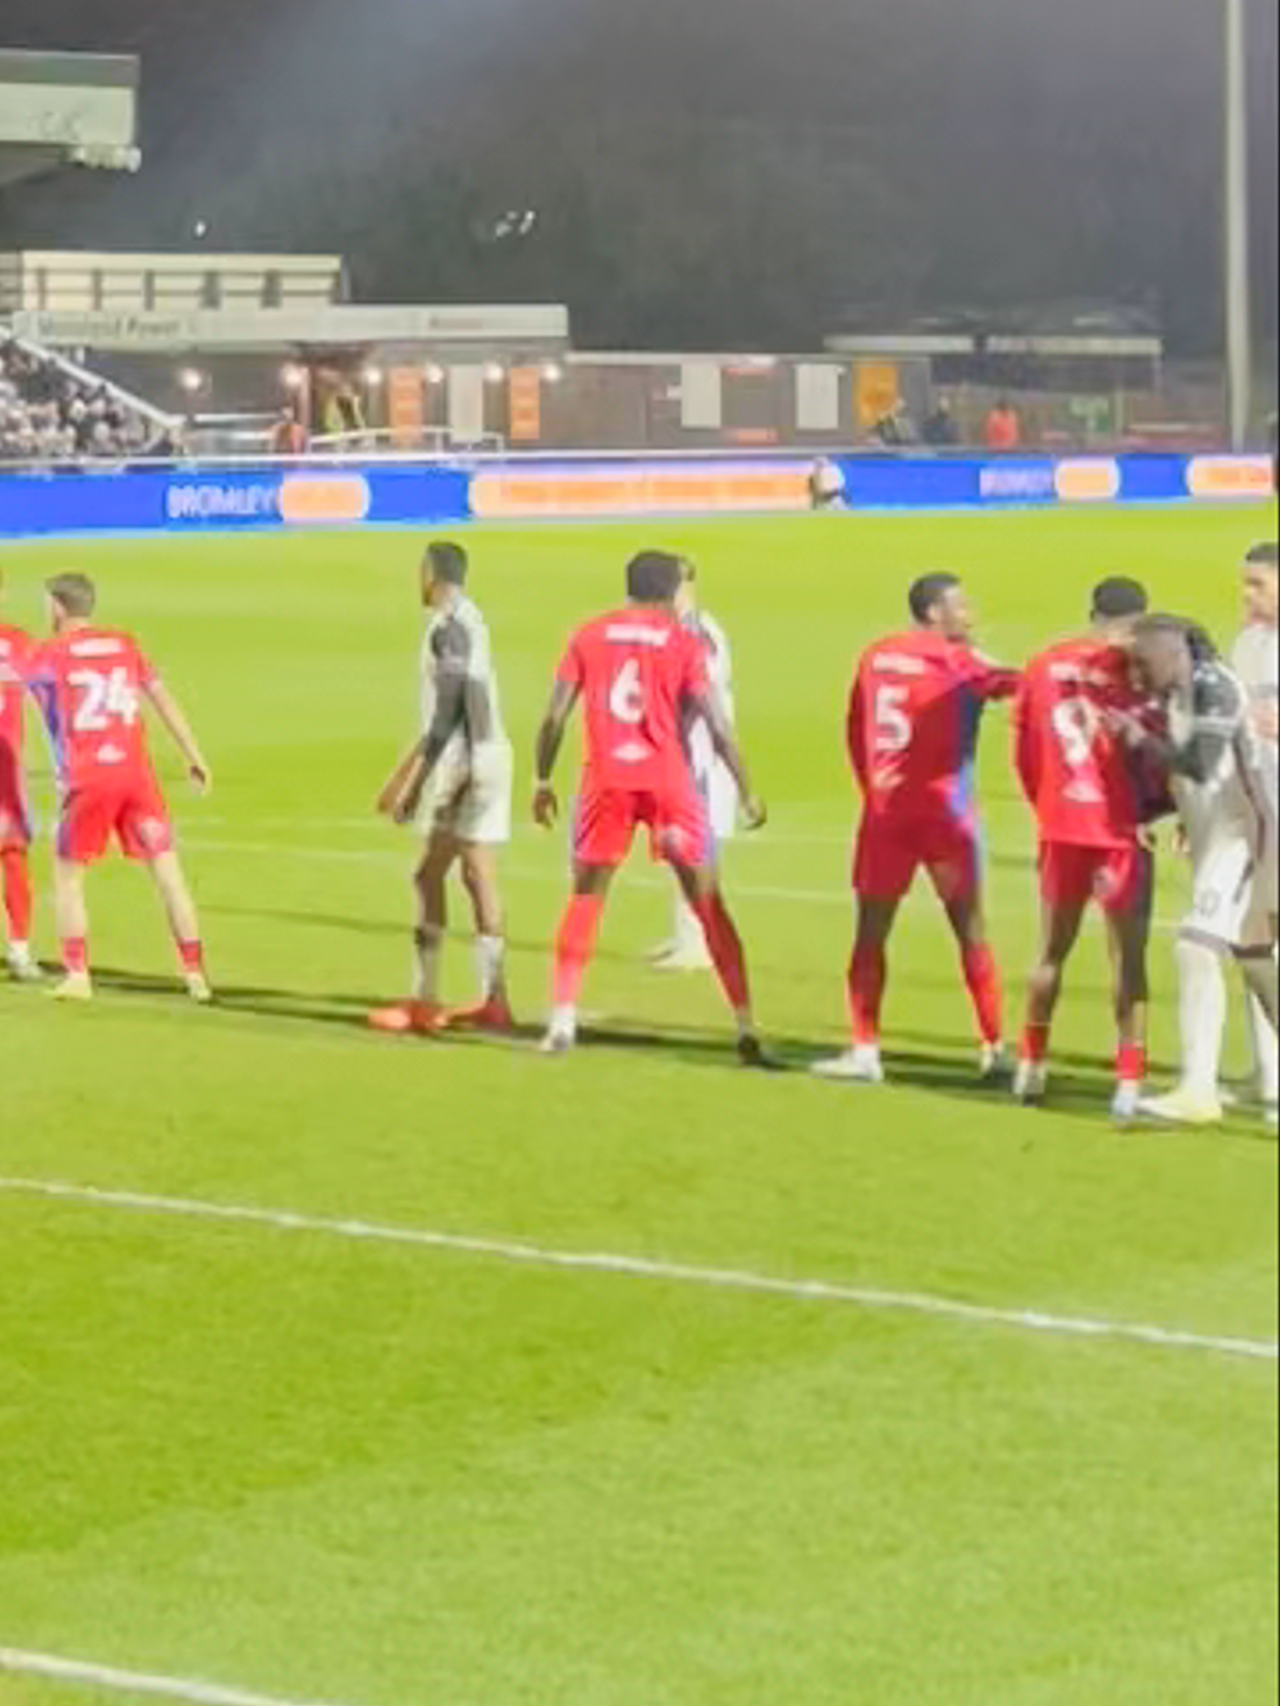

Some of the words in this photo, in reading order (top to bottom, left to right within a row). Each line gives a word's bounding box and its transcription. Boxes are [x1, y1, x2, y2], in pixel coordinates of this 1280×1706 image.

[168, 485, 278, 518] BROMLEY
[67, 667, 137, 731] 24
[609, 658, 647, 724] 6
[874, 683, 911, 753] 5
[1051, 695, 1096, 767] 9
